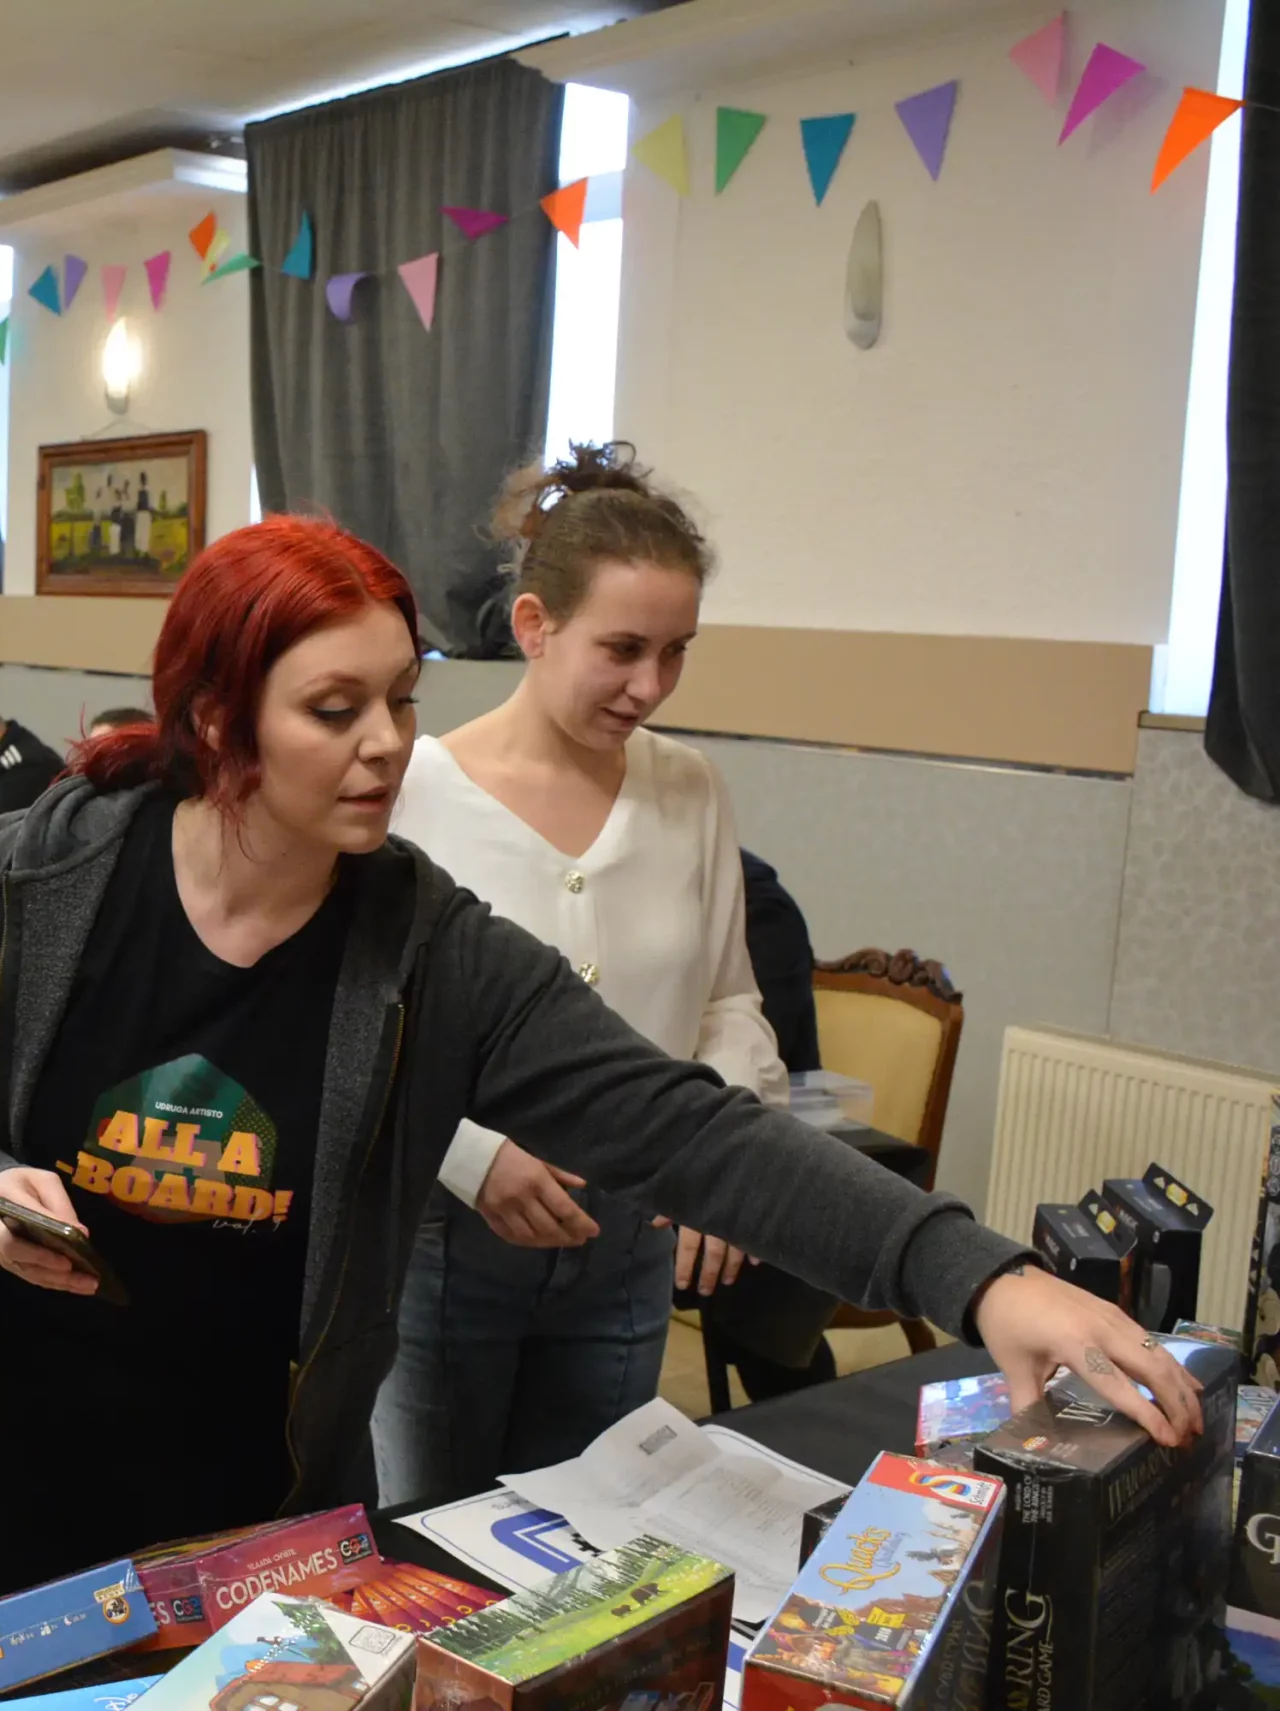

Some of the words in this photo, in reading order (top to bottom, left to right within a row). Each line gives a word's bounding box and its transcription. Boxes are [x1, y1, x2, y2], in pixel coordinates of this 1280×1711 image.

[154, 1101, 189, 1115] UDRUGA
[189, 1107, 224, 1119] ARTISTO
[98, 1110, 208, 1168] ALL
[217, 1131, 262, 1177] A
[1022, 1486, 1032, 1508] LORD
[216, 1547, 338, 1610] CODENAMES
[819, 1525, 901, 1595] Quacks
[1004, 1585, 1047, 1688] RING
[1037, 1640, 1054, 1686] GAME
